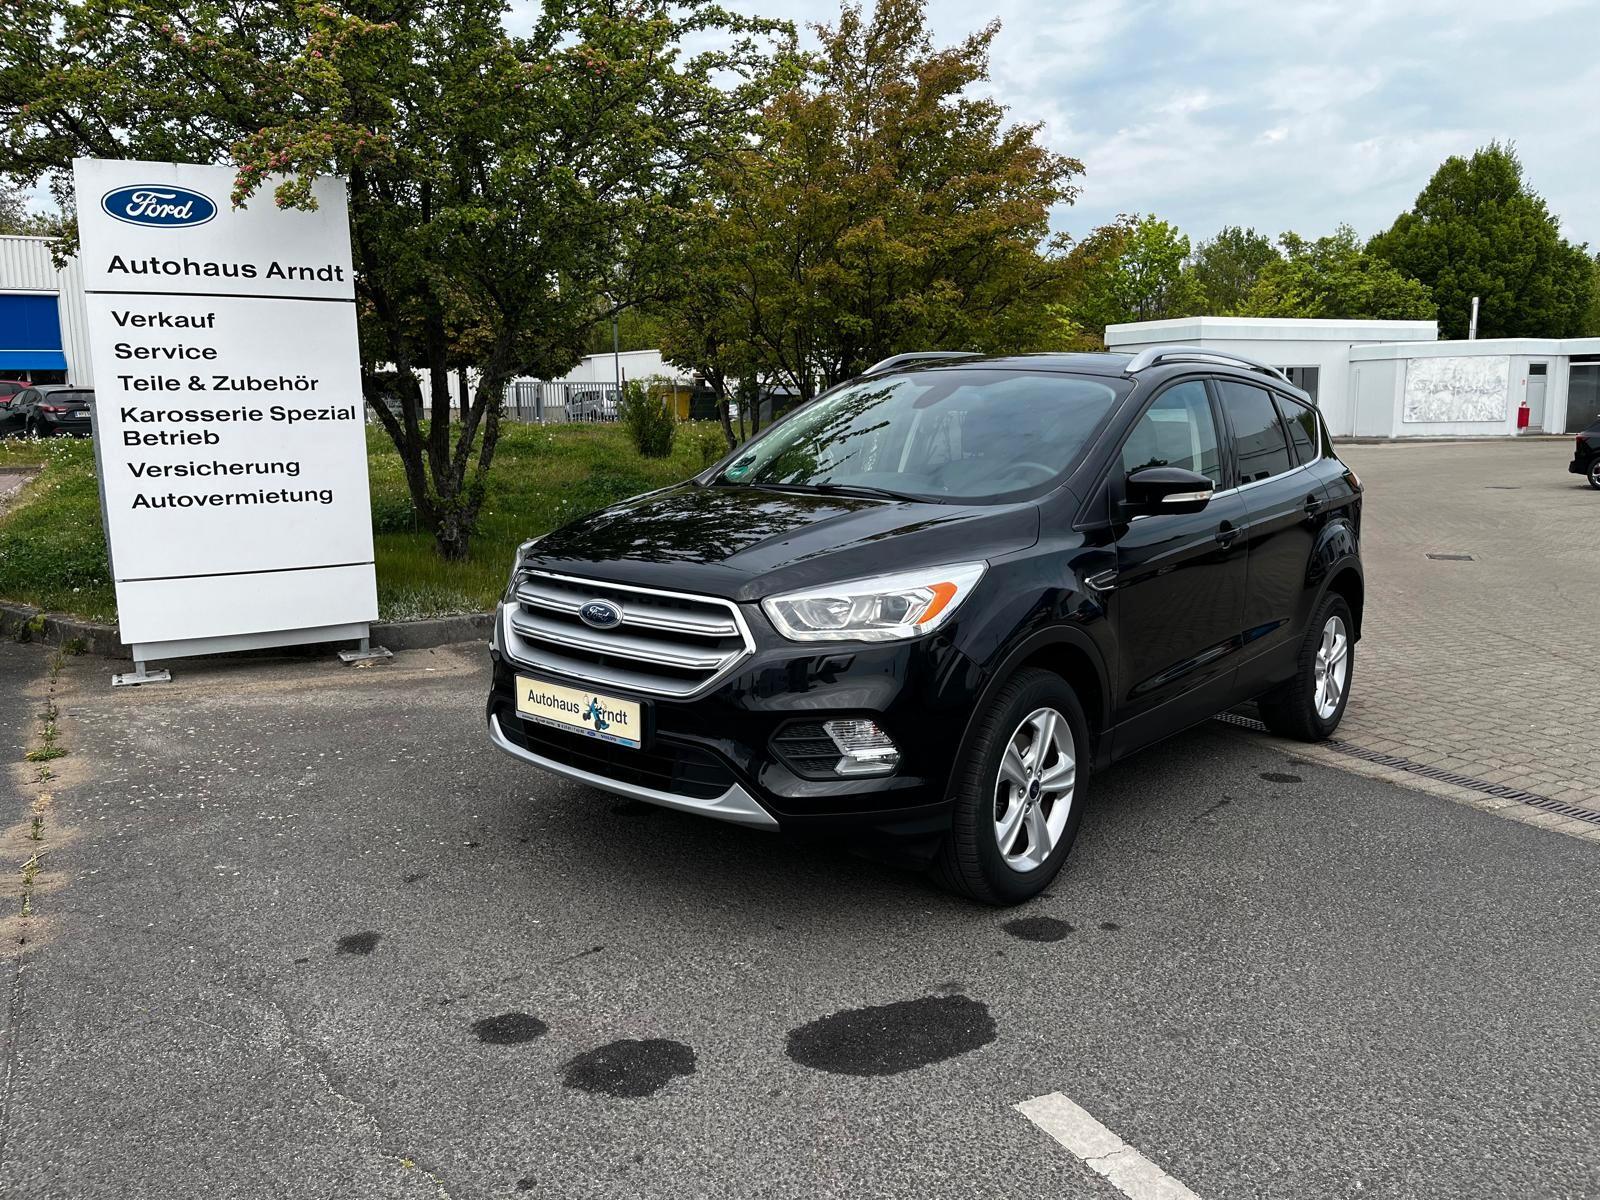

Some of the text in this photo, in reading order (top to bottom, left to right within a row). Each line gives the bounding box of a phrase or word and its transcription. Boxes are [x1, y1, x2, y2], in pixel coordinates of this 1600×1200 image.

[126, 191, 193, 219] Ford
[108, 256, 344, 281] Autohaus Arndt
[111, 311, 215, 328] Verkauf
[115, 343, 217, 359] Service
[118, 376, 318, 391] Teile & Zubehör
[121, 406, 355, 424] Karosserie Spezial
[124, 430, 219, 445] Betrieb
[127, 461, 299, 477] Versicherung
[132, 489, 332, 508] Autovermietung
[587, 606, 610, 620] Ford
[528, 689, 580, 714] Autohaus
